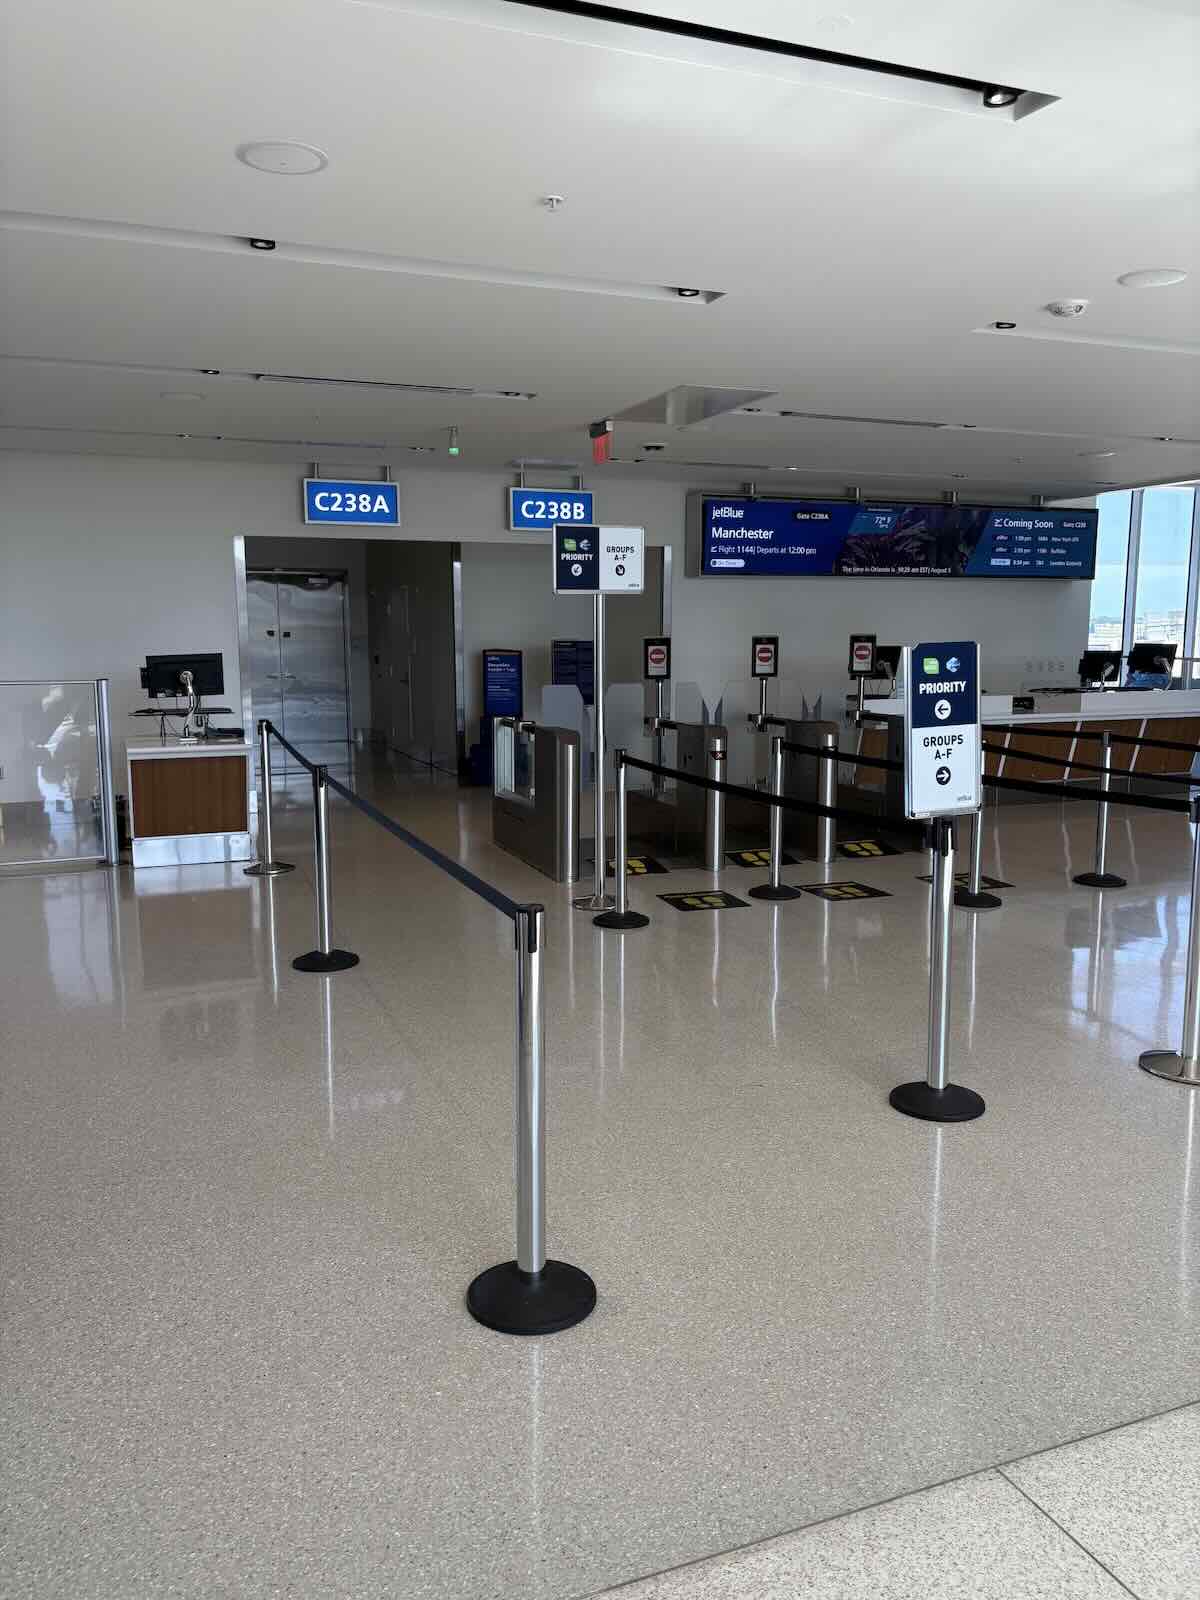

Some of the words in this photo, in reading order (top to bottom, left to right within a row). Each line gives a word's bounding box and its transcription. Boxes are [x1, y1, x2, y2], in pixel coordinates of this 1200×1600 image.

[314, 492, 390, 513] C238A
[521, 500, 585, 520] C238B
[711, 506, 744, 520] jetBlue
[1003, 519, 1033, 530] Coming
[1034, 519, 1054, 529] Soon
[711, 527, 774, 539] Manchester
[606, 545, 635, 553] GROUPS
[718, 545, 735, 554] Flight
[756, 545, 779, 555] Departs
[788, 545, 805, 555] 12:00
[561, 553, 593, 561] PRIORITY
[614, 553, 627, 561] A-F
[920, 681, 967, 694] PRIORITY
[923, 735, 964, 747] GROUPS
[934, 748, 953, 760] A-F
